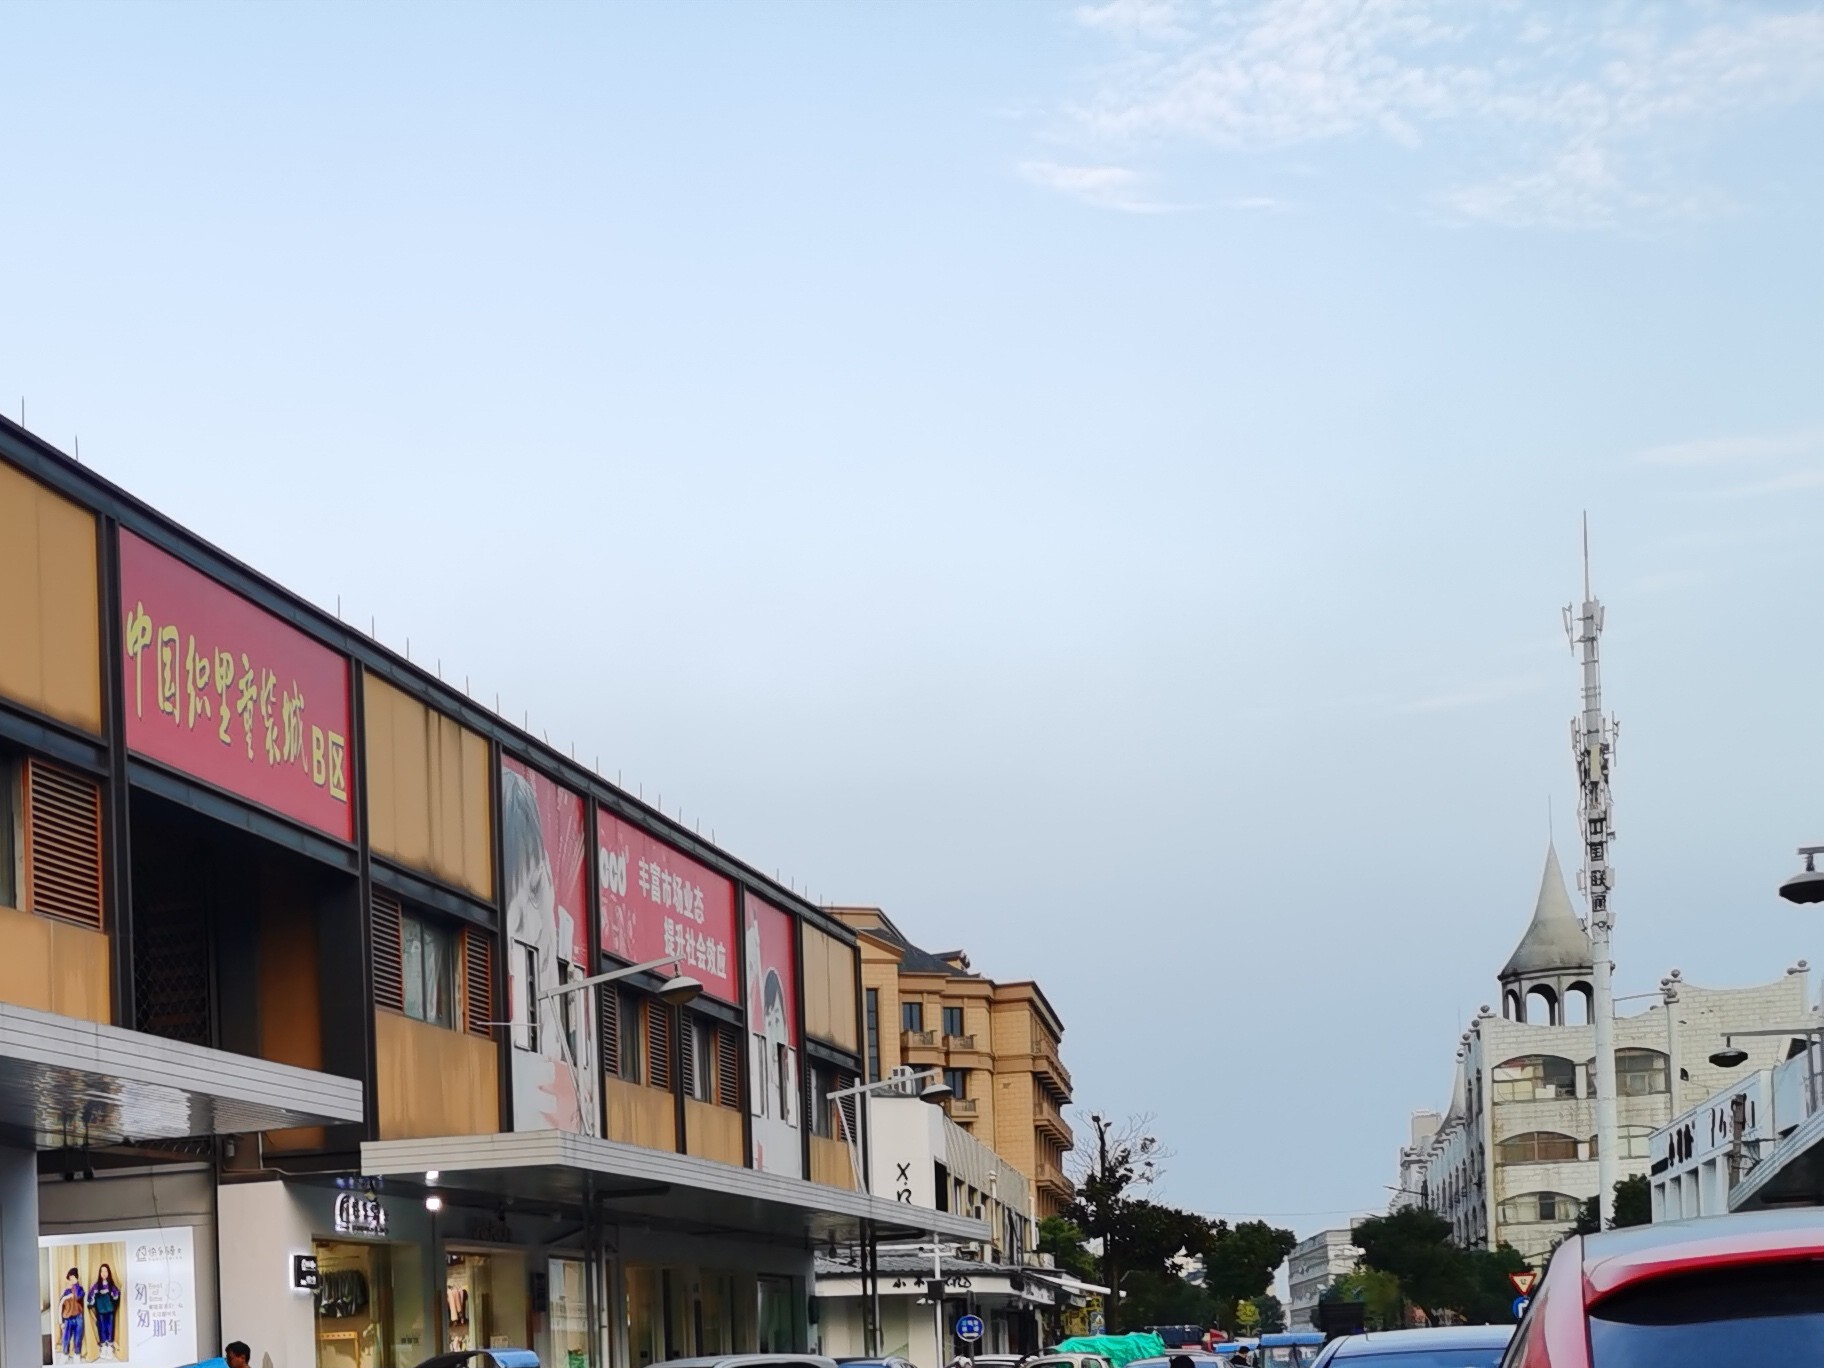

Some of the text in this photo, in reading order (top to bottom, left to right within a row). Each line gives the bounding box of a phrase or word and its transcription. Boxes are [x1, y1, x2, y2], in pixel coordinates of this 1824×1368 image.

[638, 857, 704, 924] 丰富市场业态
[664, 915, 727, 979] 提升社会效应
